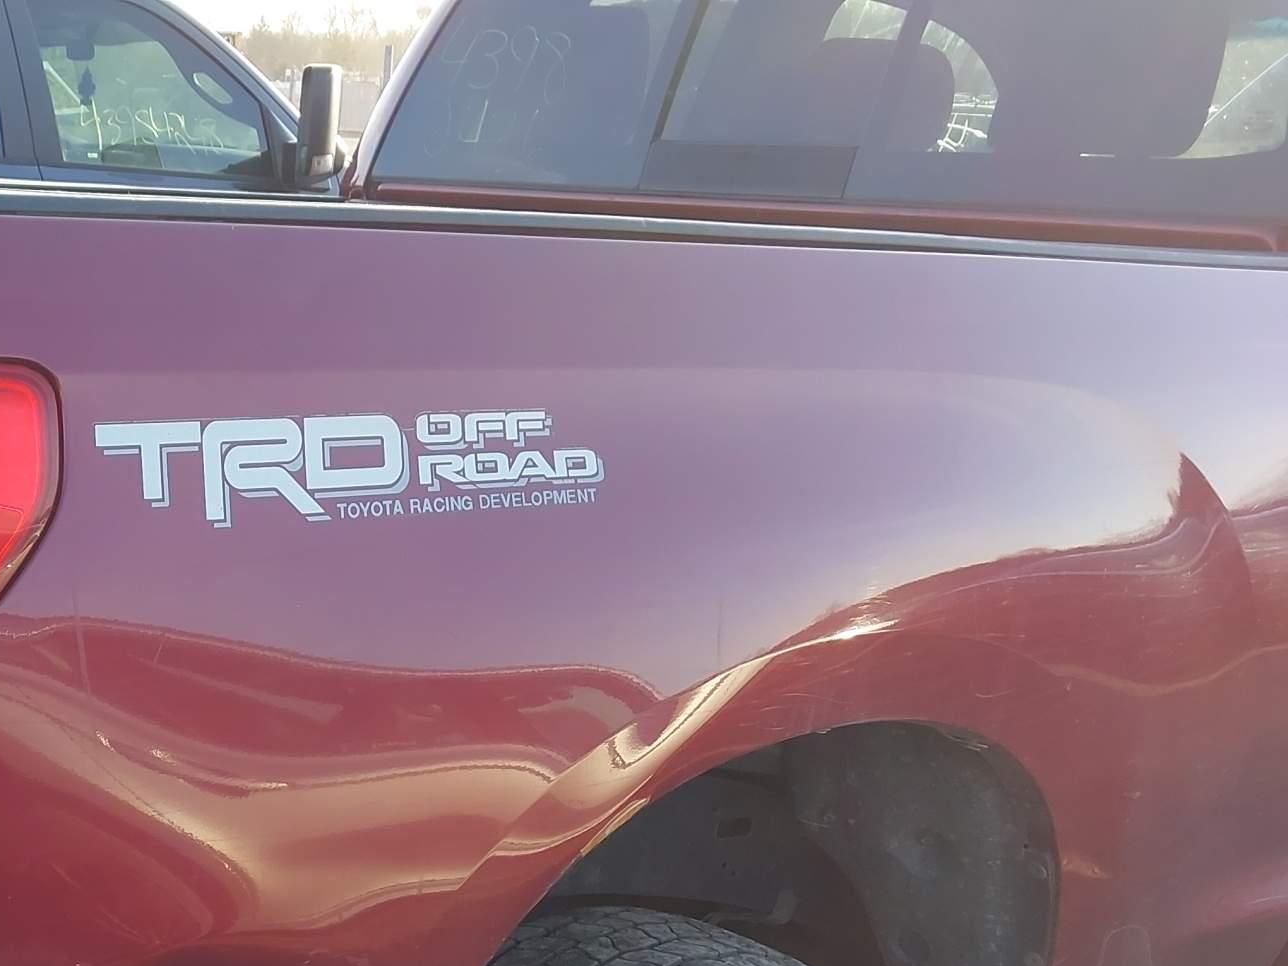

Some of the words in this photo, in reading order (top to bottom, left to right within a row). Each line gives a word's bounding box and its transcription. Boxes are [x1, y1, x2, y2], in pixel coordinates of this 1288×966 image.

[415, 411, 553, 451] OFF
[94, 413, 410, 528] TRD
[417, 449, 605, 492] ROAD
[337, 502, 404, 519] TOYOTA
[409, 496, 474, 515] RACING
[478, 488, 598, 510] DEVELOPMENT
